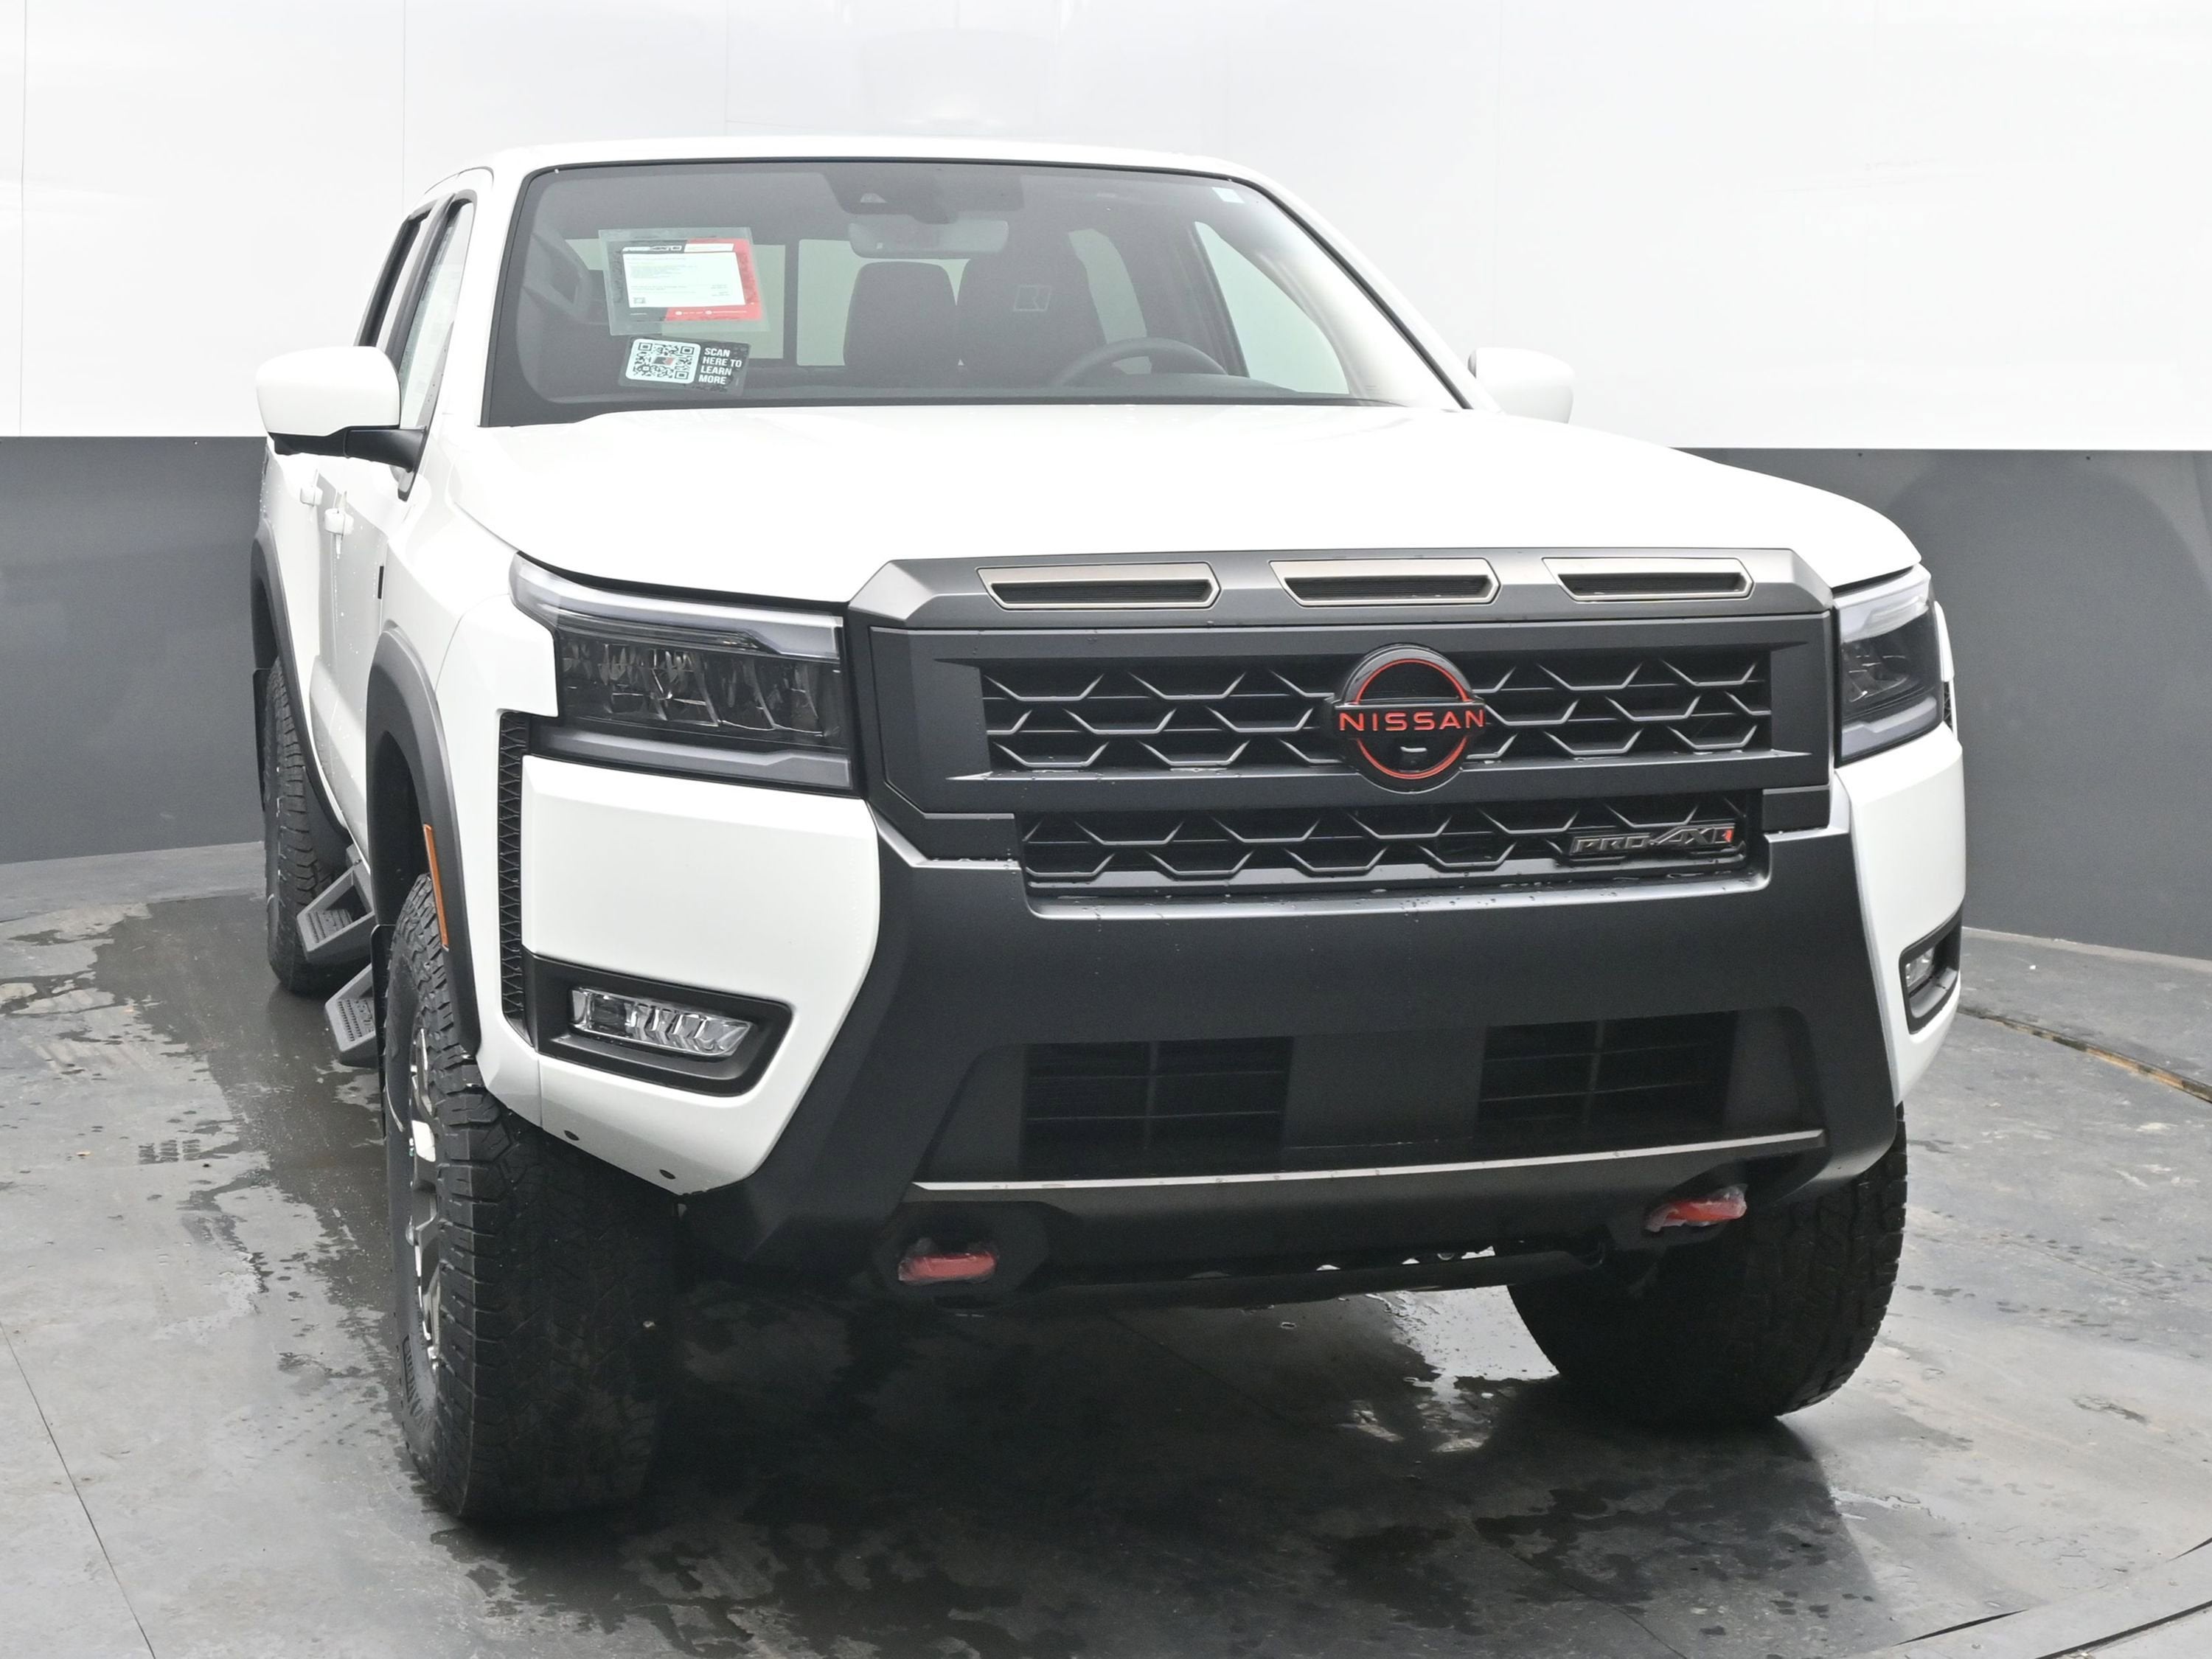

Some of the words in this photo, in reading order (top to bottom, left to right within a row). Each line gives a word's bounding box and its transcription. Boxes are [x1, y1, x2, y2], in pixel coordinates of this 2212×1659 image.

[704, 347, 731, 358] SCAN
[703, 356, 728, 366] HERE
[730, 358, 742, 368] TO
[700, 365, 732, 376] LEARN
[698, 375, 727, 385] MORE
[1339, 709, 1484, 731] NISSAN
